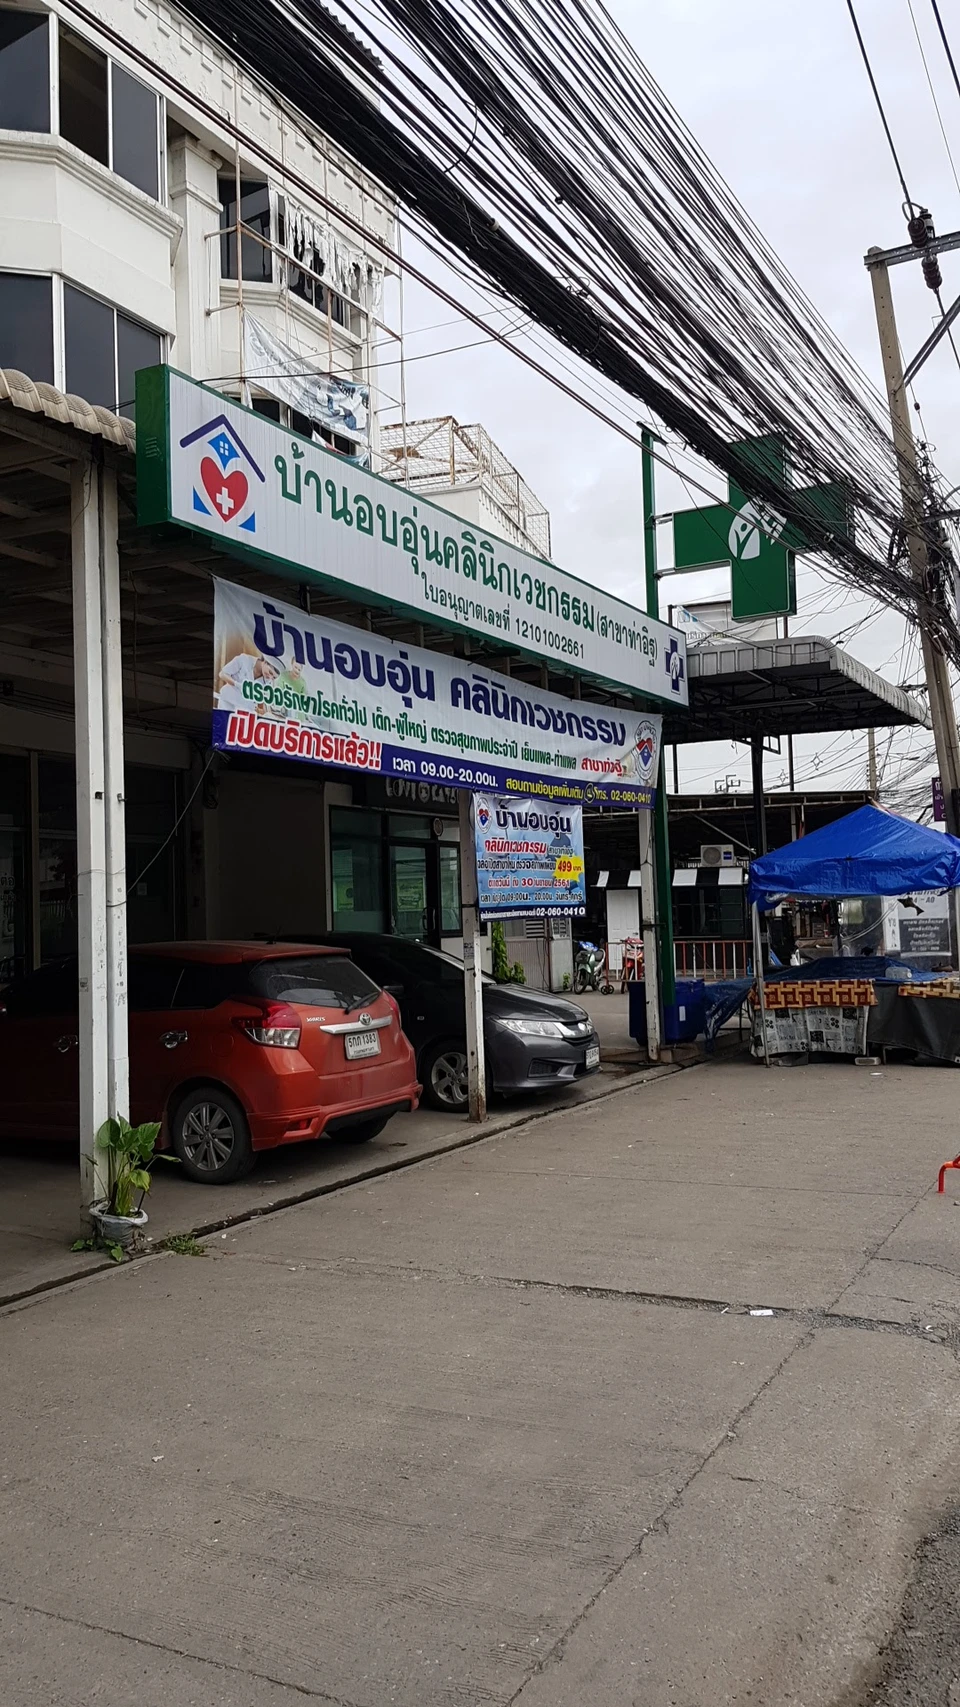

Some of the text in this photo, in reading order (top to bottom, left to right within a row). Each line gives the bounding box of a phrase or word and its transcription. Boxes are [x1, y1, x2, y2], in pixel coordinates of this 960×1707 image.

[421, 571, 584, 659] ใบอนุญาตเลขที่ 12101002661
[253, 601, 627, 747] บ้านอบอุ่น คลินิกเวชกรรม
[242, 679, 367, 726] ตรวจรักษาโรคทั่วไป
[372, 706, 427, 744] เด็ก-ผู้ใหญ่
[226, 709, 382, 769] เปิดบริการแล้ว!!
[392, 757, 416, 774] เวลา
[420, 760, 499, 788] 09.00-20.00น.
[495, 804, 572, 838] บ้านอบอุ่น
[485, 837, 547, 854] คลินิกเวชกรรม
[521, 878, 534, 886] 30
[554, 878, 570, 887] 2561
[557, 860, 572, 872] 499
[536, 907, 586, 917] 02-060-0410
